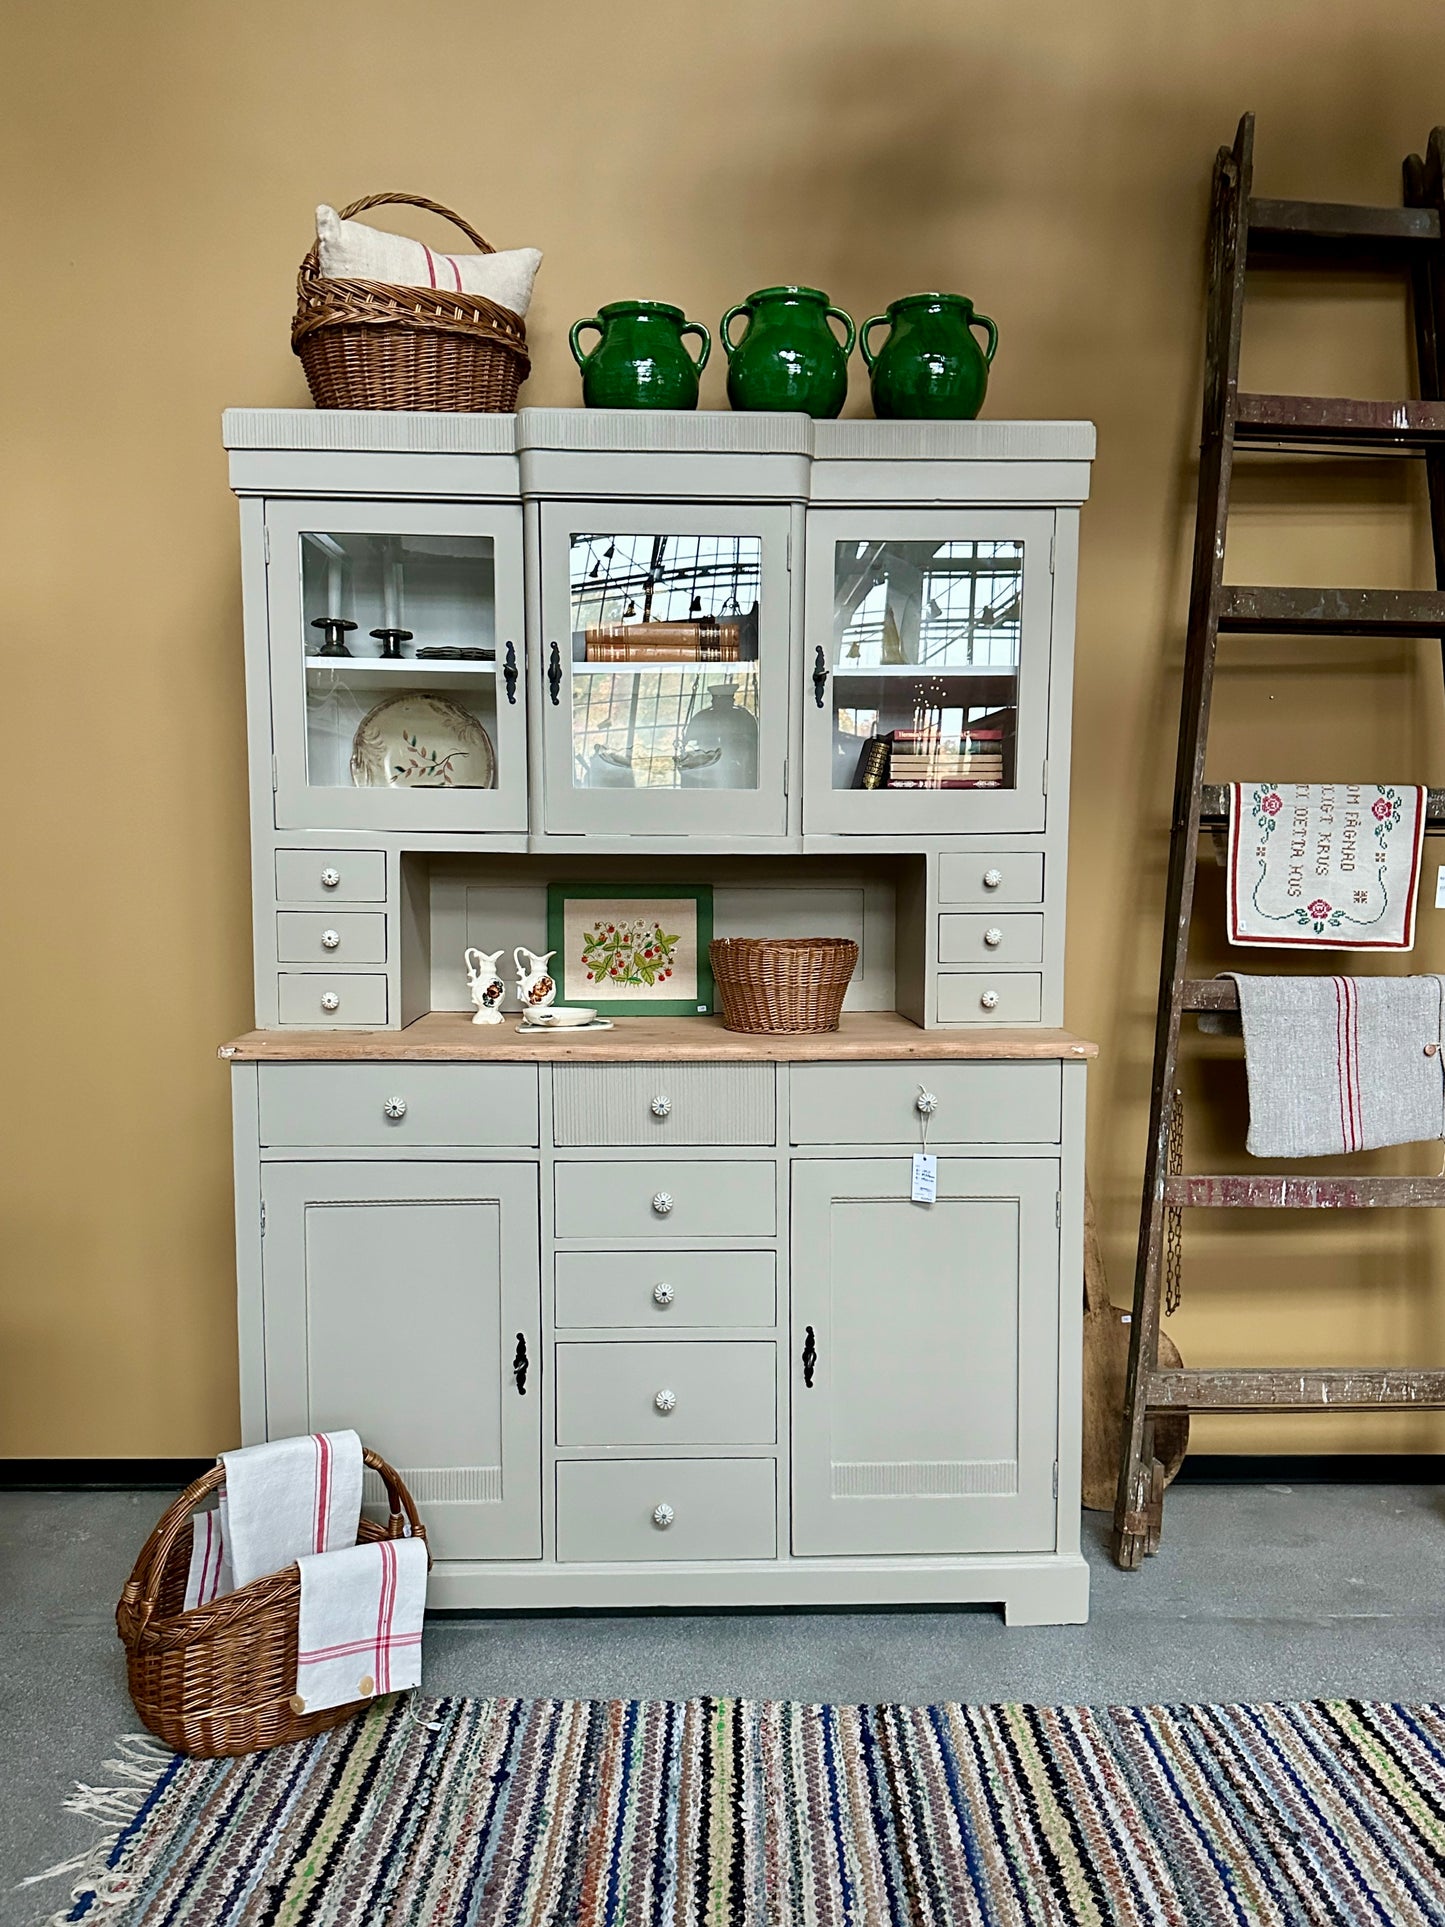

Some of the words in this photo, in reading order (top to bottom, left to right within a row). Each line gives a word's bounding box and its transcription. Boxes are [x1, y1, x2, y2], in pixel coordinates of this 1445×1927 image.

[1320, 784, 1335, 824] LIGT
[1290, 806, 1308, 858] DETTA
[1315, 832, 1331, 876] KRUS
[1287, 864, 1304, 897] HUS
